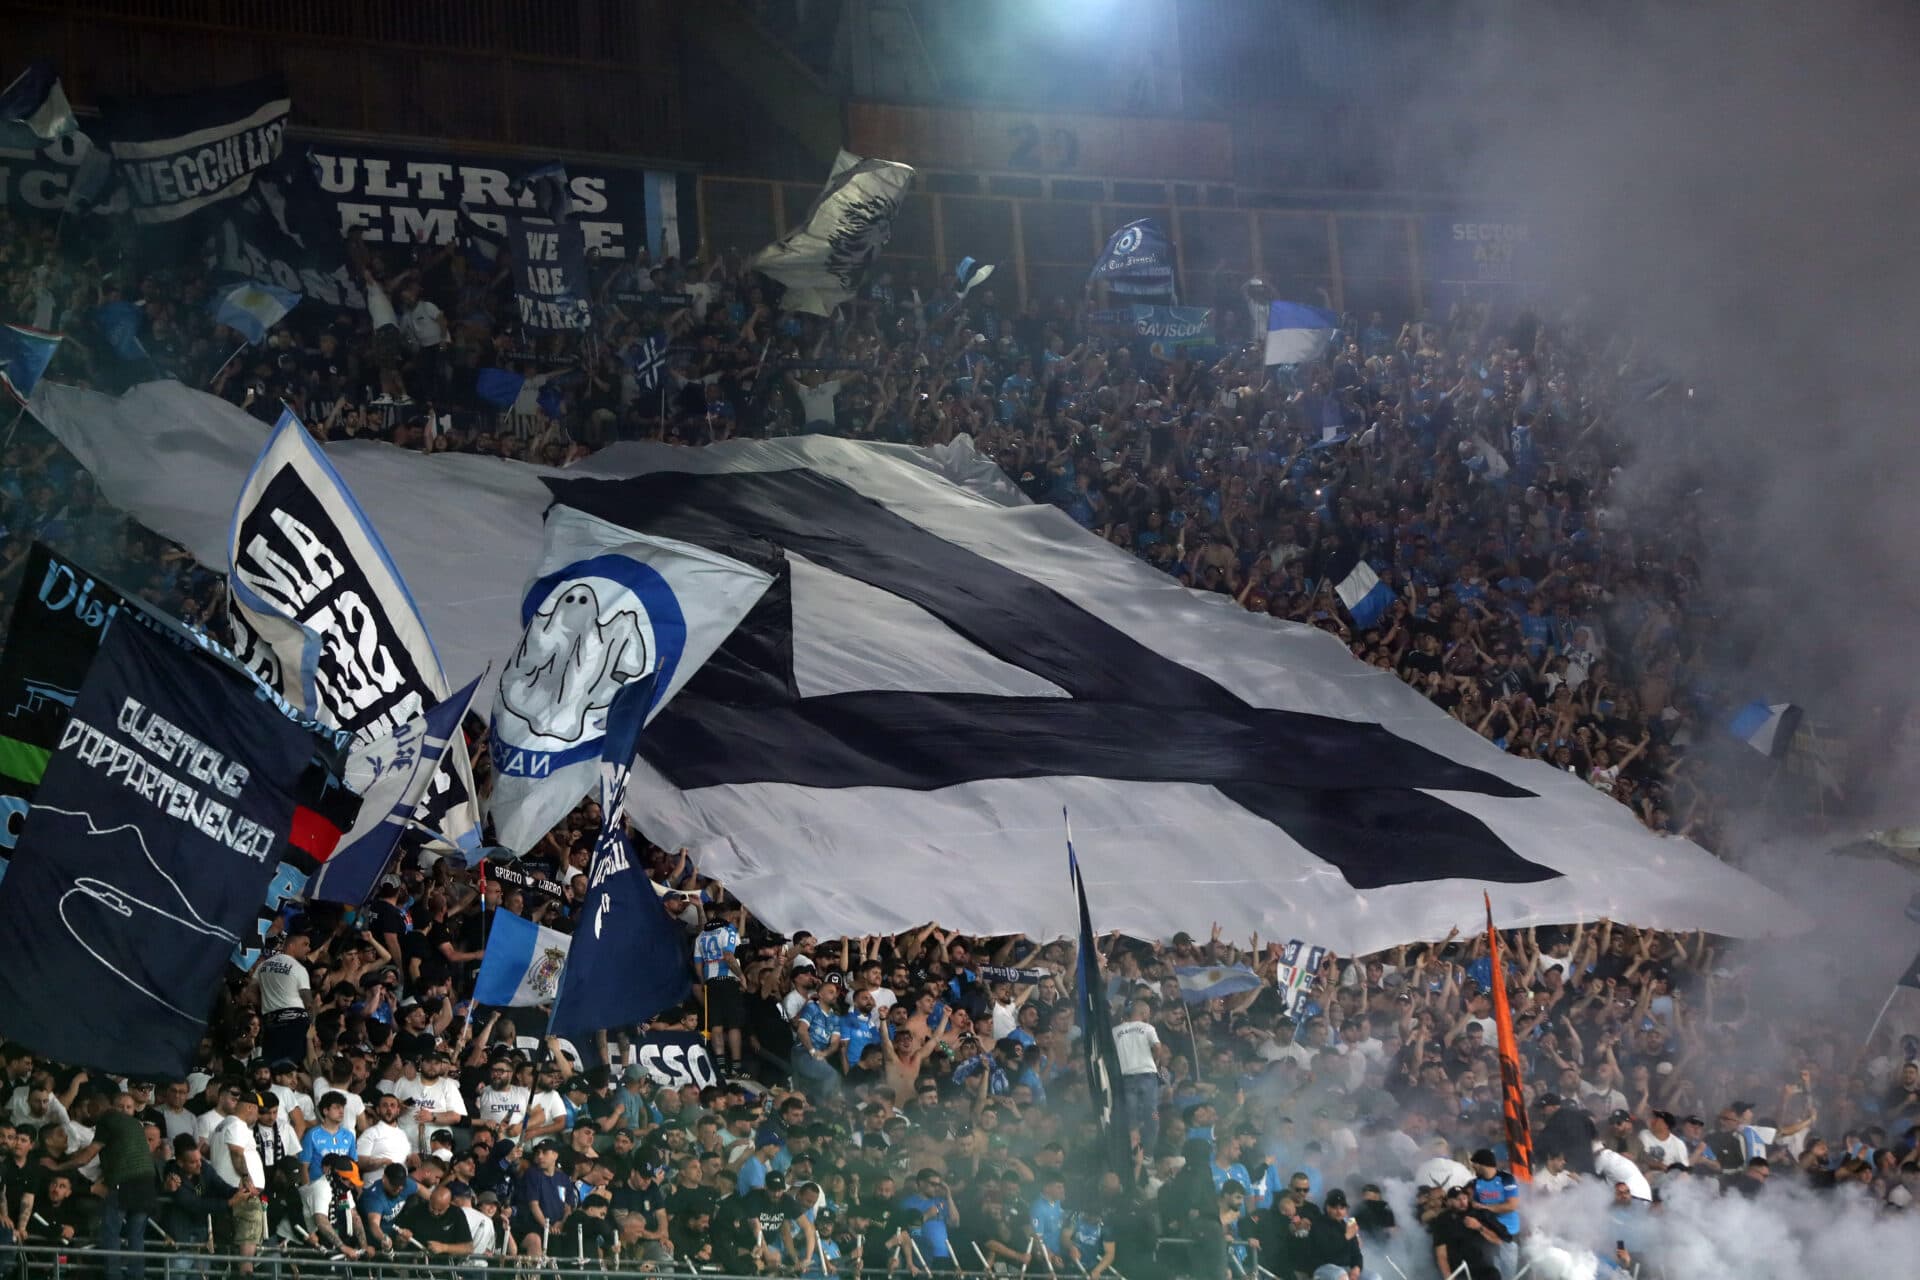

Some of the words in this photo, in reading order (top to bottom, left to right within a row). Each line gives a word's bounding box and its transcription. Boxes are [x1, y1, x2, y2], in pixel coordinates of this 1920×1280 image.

[124, 131, 246, 203] VECCHI
[337, 202, 625, 258] EMPE
[525, 231, 559, 261] WE
[527, 266, 565, 295] ARE
[494, 866, 522, 885] SPIRITO
[415, 1099, 435, 1108] REW
